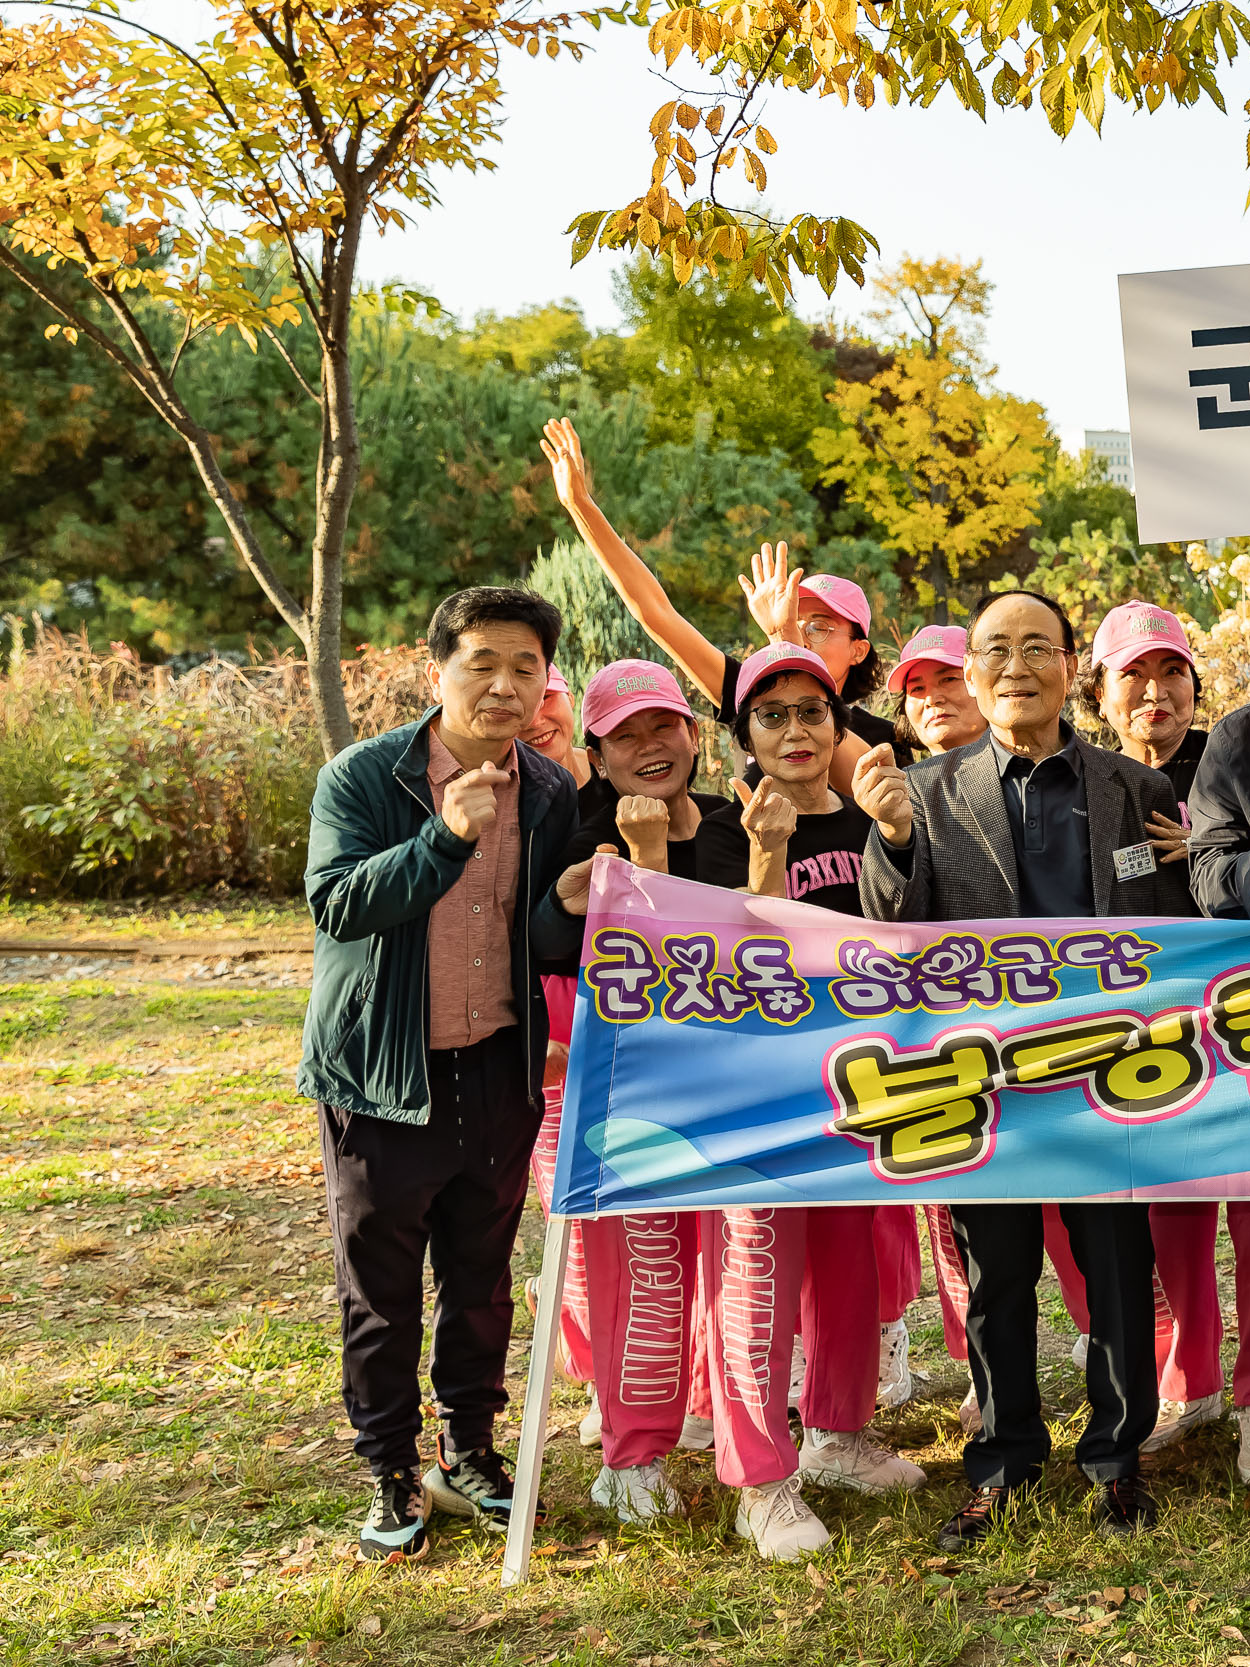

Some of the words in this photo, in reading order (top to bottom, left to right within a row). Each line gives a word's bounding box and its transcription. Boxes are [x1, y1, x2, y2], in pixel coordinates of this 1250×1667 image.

[617, 675, 656, 688] BONNE
[616, 682, 660, 696] CHANCE
[590, 932, 808, 1021] 군자동
[834, 934, 1158, 1014] 응원군단
